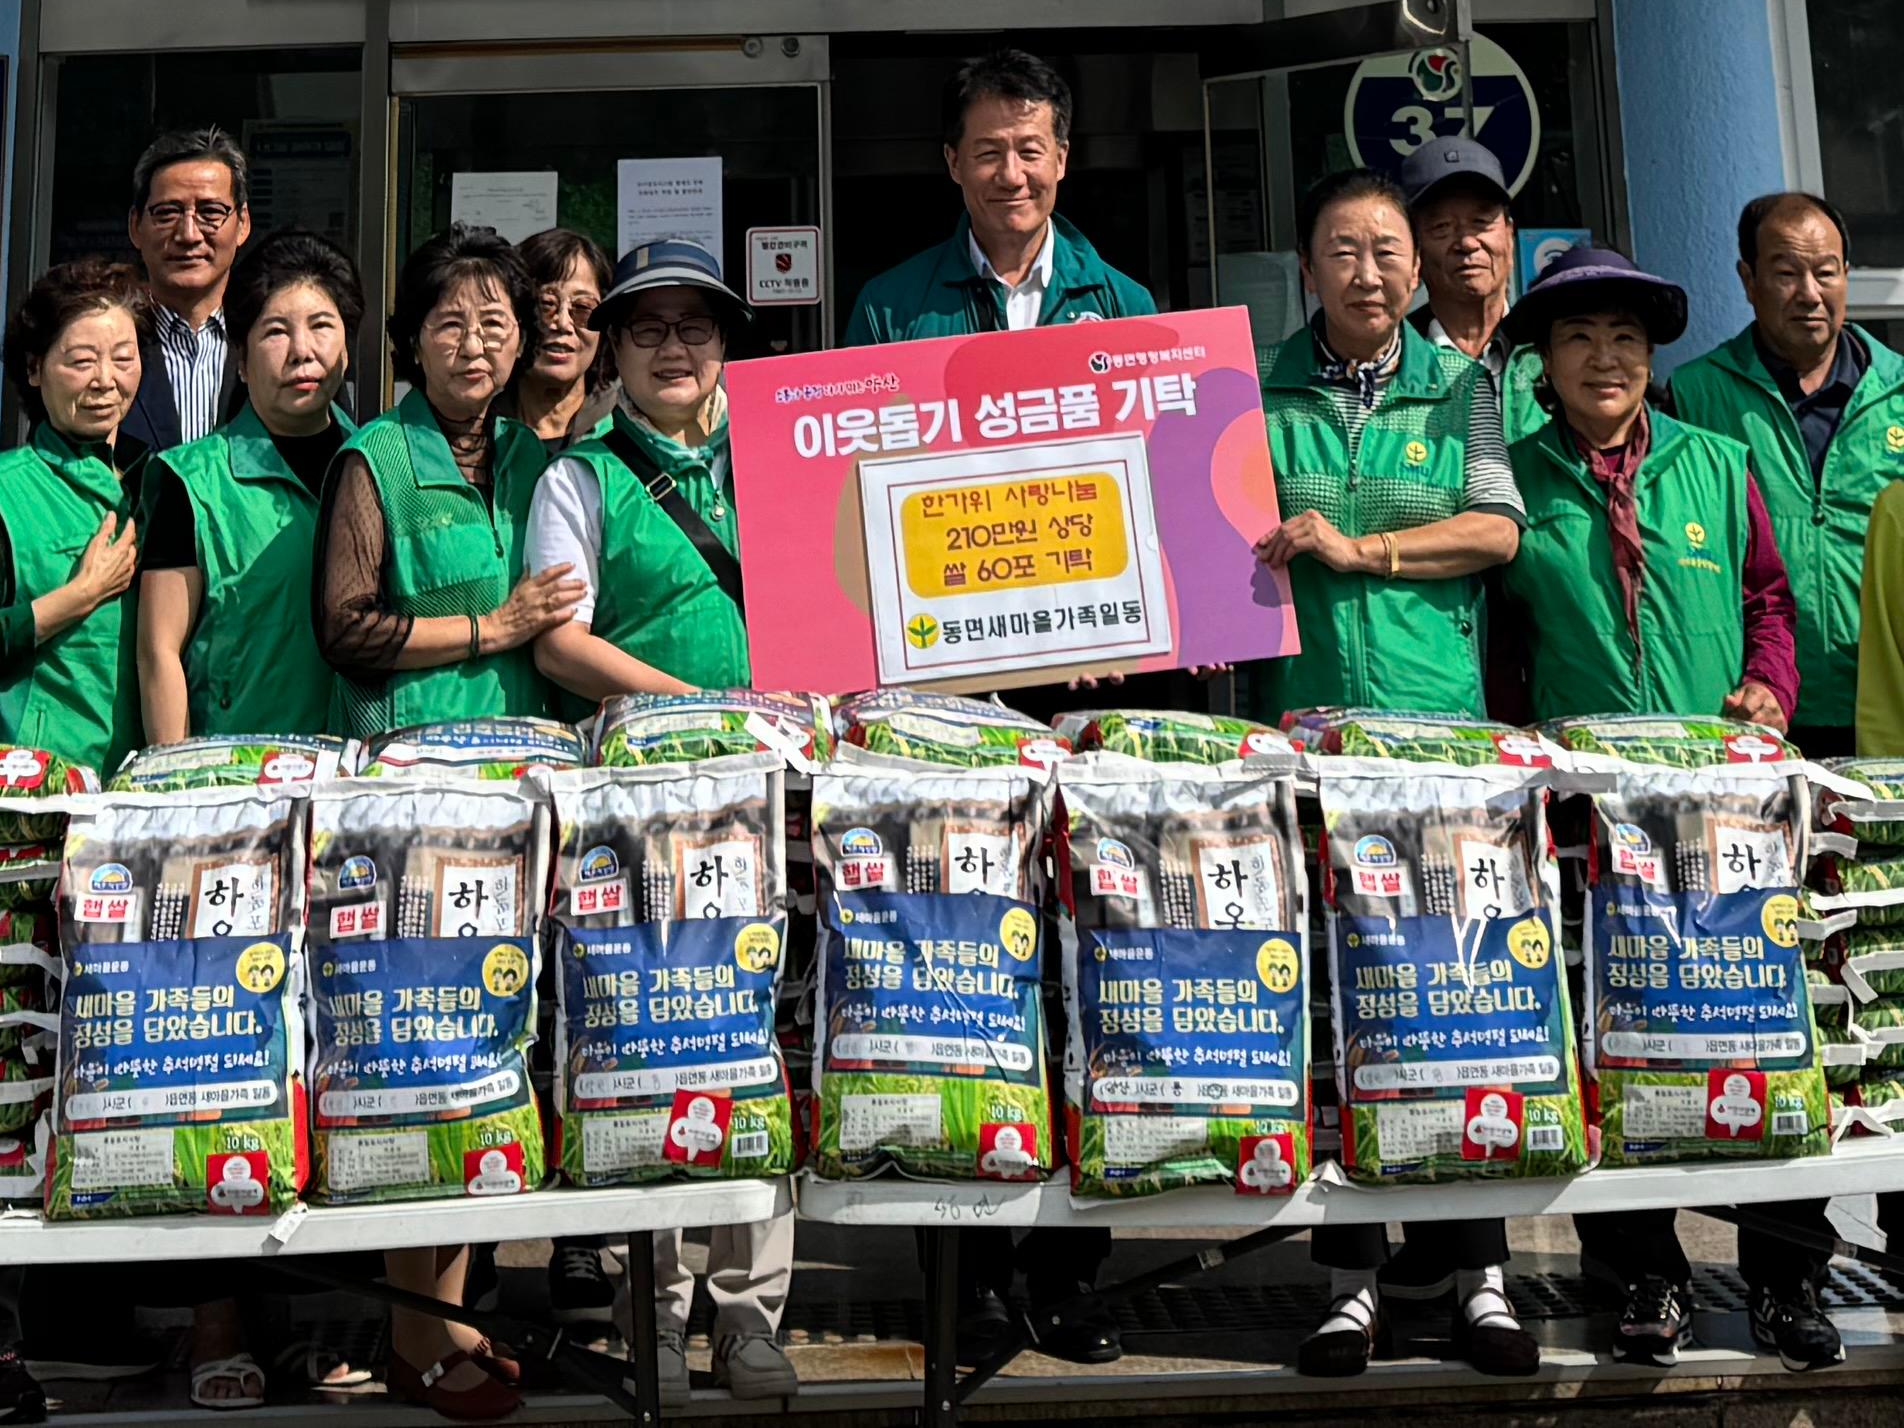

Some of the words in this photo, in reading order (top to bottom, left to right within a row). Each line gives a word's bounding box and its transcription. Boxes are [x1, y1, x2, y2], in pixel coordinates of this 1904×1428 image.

[793, 398, 963, 458] 이웃돕기
[975, 384, 1101, 441] 성금품
[1111, 372, 1197, 423] 기탁
[921, 489, 992, 518] 한가위
[1005, 479, 1097, 507] 사랑나눔
[946, 519, 1038, 551] 210만원
[1048, 513, 1094, 540] 상당
[943, 561, 967, 587] 쌀
[977, 555, 1036, 582] 60포
[1046, 547, 1093, 574] 기탁
[942, 600, 1142, 644] 동면새마을가족일동
[844, 938, 906, 965] 새마을
[1608, 935, 1670, 961] 새마을
[1679, 936, 1764, 961] 가족들의
[583, 971, 640, 998] 새마을
[649, 965, 735, 992] 가족들의
[846, 963, 903, 991] 정성을
[1356, 963, 1418, 990] 새마을
[1608, 962, 1670, 990] 정성을
[75, 990, 136, 1018] 새마을
[146, 985, 234, 1012] 가족들의
[392, 986, 480, 1012] 가족들의
[1098, 979, 1163, 1005] 새마을
[1172, 979, 1257, 1005] 가족들의
[1356, 991, 1418, 1020] 정성을
[1428, 987, 1542, 1015] 담았습니다.
[585, 1000, 639, 1028] 정성을
[1099, 1007, 1163, 1034] 정성을
[1173, 1007, 1284, 1034] 담았습니다.
[73, 1019, 133, 1048] 정성을
[144, 1011, 263, 1042] 담았습니다.
[392, 1014, 498, 1043] 담았습니다.
[163, 1053, 218, 1073] 추석명절
[224, 1050, 270, 1067] 되세요!
[734, 1116, 746, 1129] 10
[749, 1115, 765, 1130] kg
[1528, 1109, 1541, 1123] 10
[1544, 1108, 1559, 1124] kg
[226, 1136, 239, 1149] 10
[243, 1136, 260, 1150] kg
[480, 1133, 492, 1146] 10
